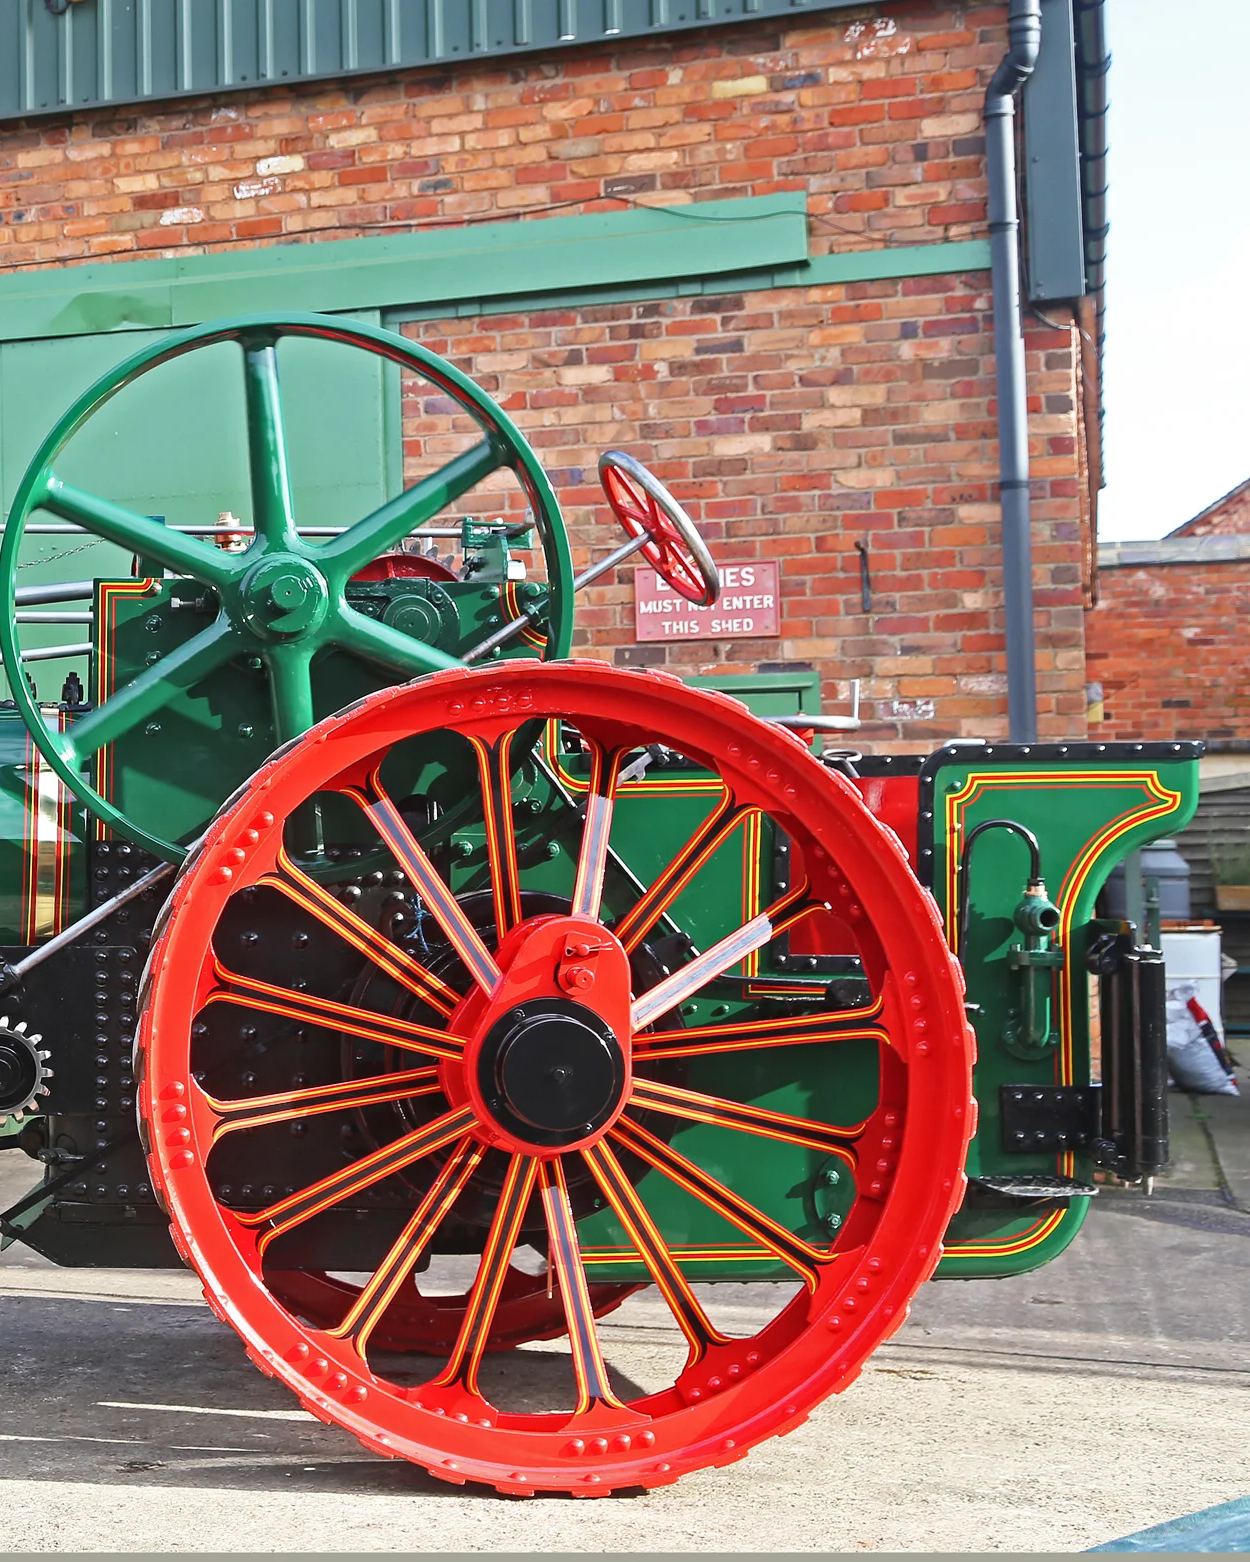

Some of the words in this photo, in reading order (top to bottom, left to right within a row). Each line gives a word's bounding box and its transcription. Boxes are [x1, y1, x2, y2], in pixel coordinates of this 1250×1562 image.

[639, 599, 682, 614] MUST
[722, 594, 774, 611] ENTER
[661, 620, 700, 635] THIS
[710, 617, 754, 633] SHED
